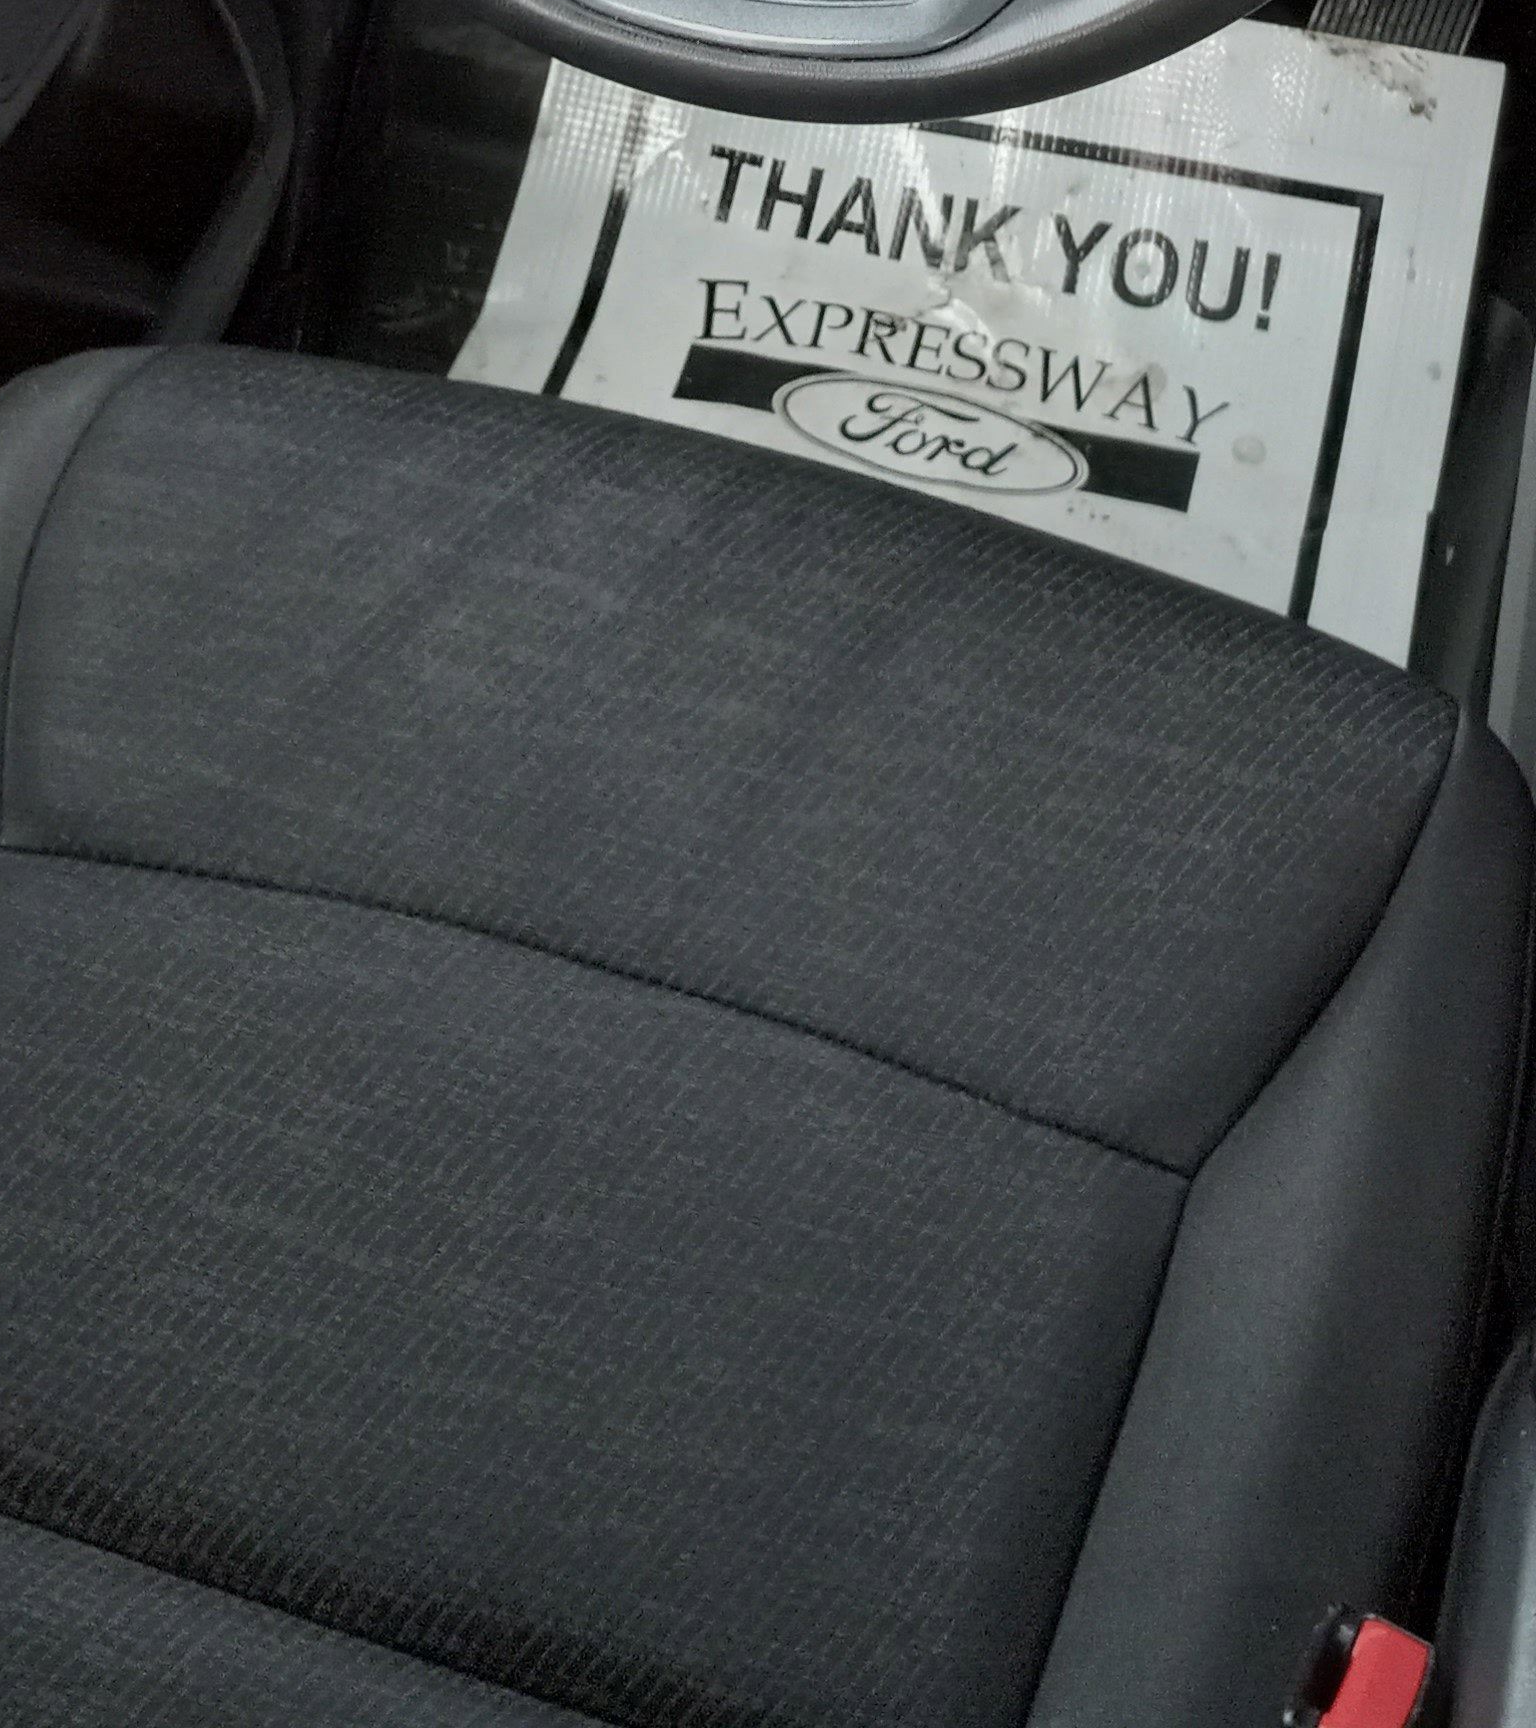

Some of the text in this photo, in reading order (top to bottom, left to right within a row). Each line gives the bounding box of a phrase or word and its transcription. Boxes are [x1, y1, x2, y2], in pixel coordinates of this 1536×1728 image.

[709, 145, 1282, 331] THANK YOU!
[696, 278, 1230, 445] EXPRESSWAY
[841, 390, 1019, 479] Ford
